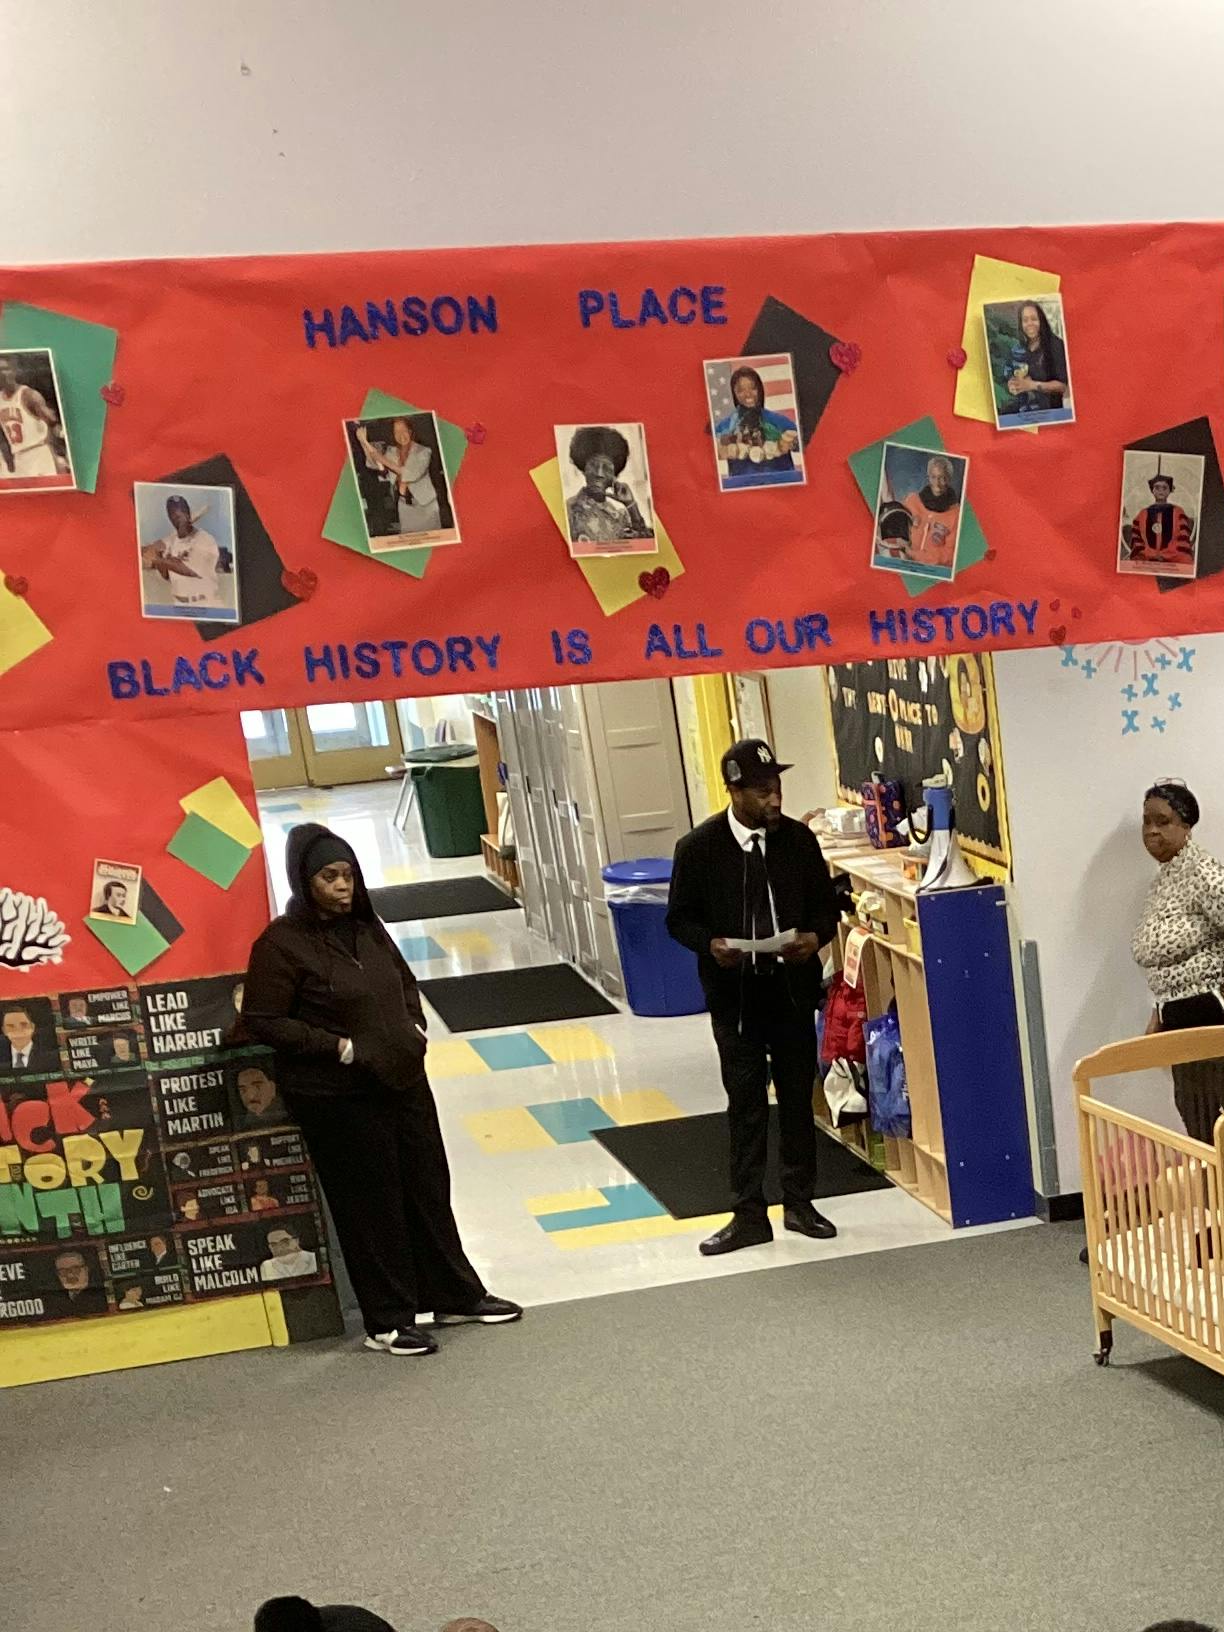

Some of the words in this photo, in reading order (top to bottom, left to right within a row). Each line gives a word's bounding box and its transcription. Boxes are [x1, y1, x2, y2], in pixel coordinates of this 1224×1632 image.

[304, 296, 497, 347] HANSON
[579, 286, 726, 329] PLACE
[108, 651, 263, 699] BLACK
[304, 636, 500, 682] HISTORY
[551, 629, 593, 666] IS
[646, 624, 722, 659] ALL
[746, 614, 832, 655] OUR
[870, 602, 1038, 643] HISTORY
[146, 991, 188, 1013] LEAD
[150, 1012, 187, 1033] LIKE
[153, 1028, 222, 1054] HARRIET
[160, 1069, 225, 1095] PROTEST
[164, 1096, 198, 1116] LIKE
[167, 1111, 225, 1136] MARTIN
[187, 1233, 236, 1256] SPEAK
[191, 1253, 224, 1274] LIKE
[194, 1266, 260, 1292] MALCOLM
